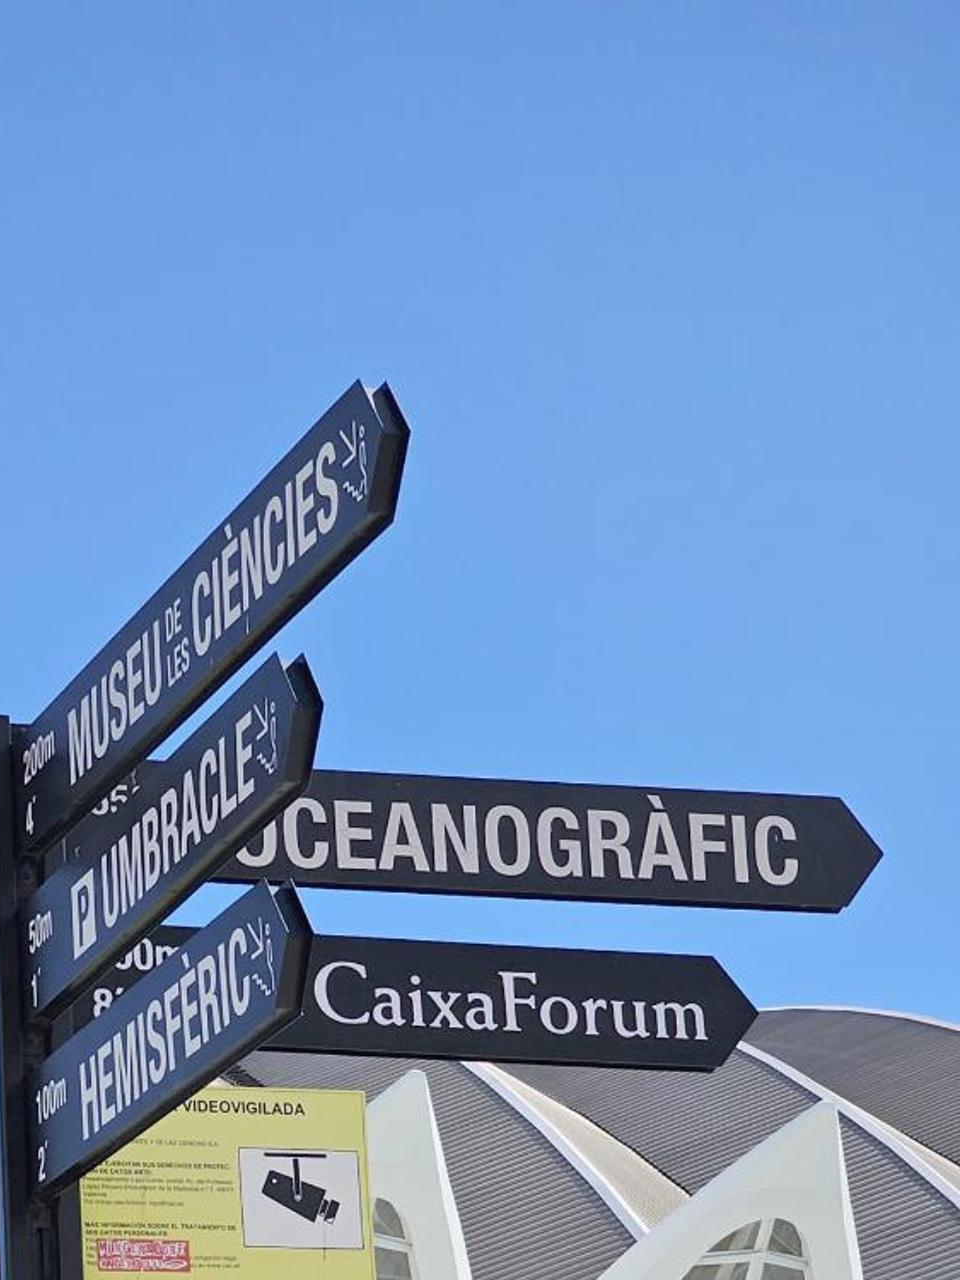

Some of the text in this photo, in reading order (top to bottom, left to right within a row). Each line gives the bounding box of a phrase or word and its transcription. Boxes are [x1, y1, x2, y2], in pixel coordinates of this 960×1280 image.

[191, 441, 339, 657] CIÈNCIES
[165, 598, 182, 643] DE
[166, 636, 191, 688] LES
[68, 620, 162, 786] MUSEU
[23, 730, 55, 785] 200m
[101, 711, 255, 929] UMBRACLE
[29, 910, 53, 955] 50m
[315, 961, 709, 1041] CaixaForum
[79, 927, 251, 1141] HEMISFÈRIC
[36, 1078, 66, 1124] 100m
[183, 1100, 305, 1116] VIDEOVIGILADA
